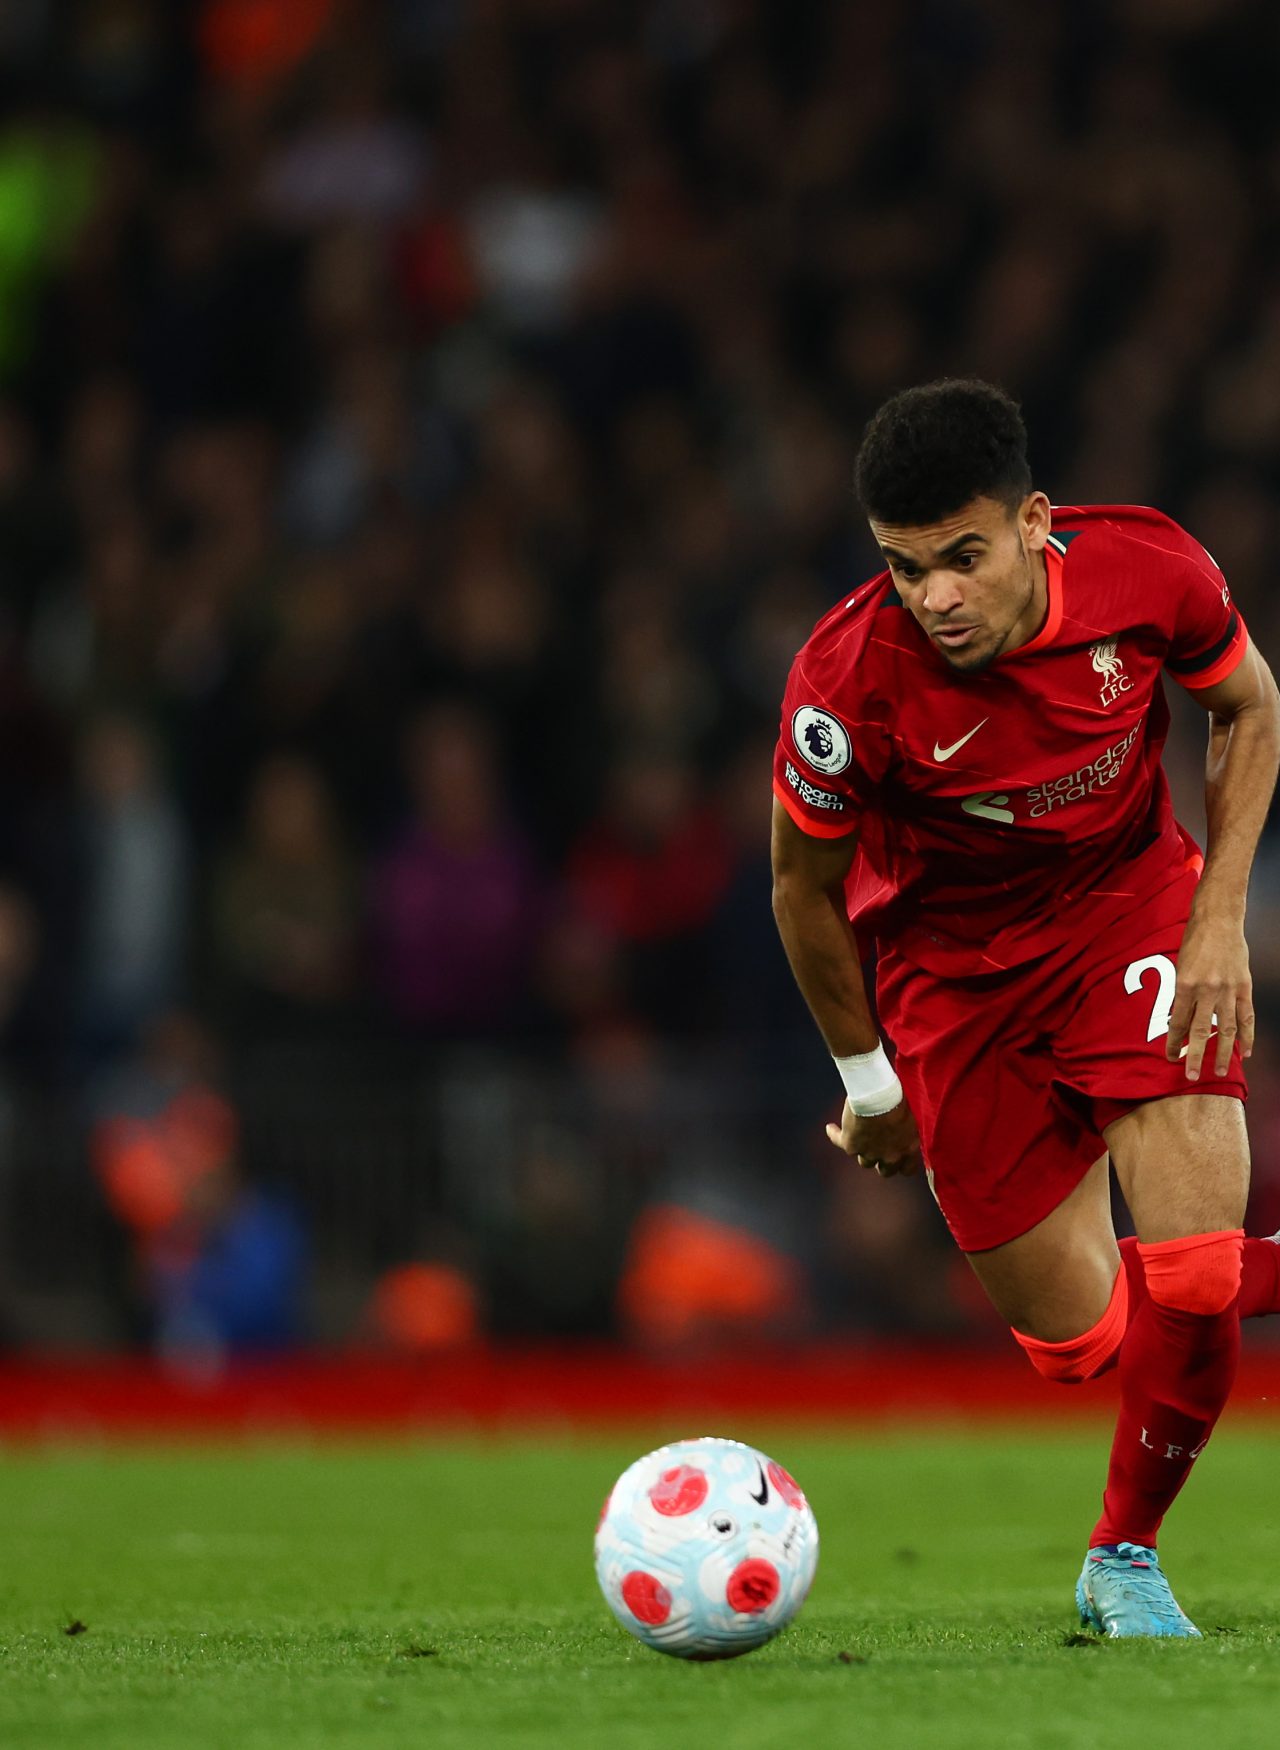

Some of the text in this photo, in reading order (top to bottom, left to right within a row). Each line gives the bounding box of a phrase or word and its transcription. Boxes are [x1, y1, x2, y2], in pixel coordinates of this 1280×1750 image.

[786, 762, 837, 801] No room
[799, 787, 843, 810] racism
